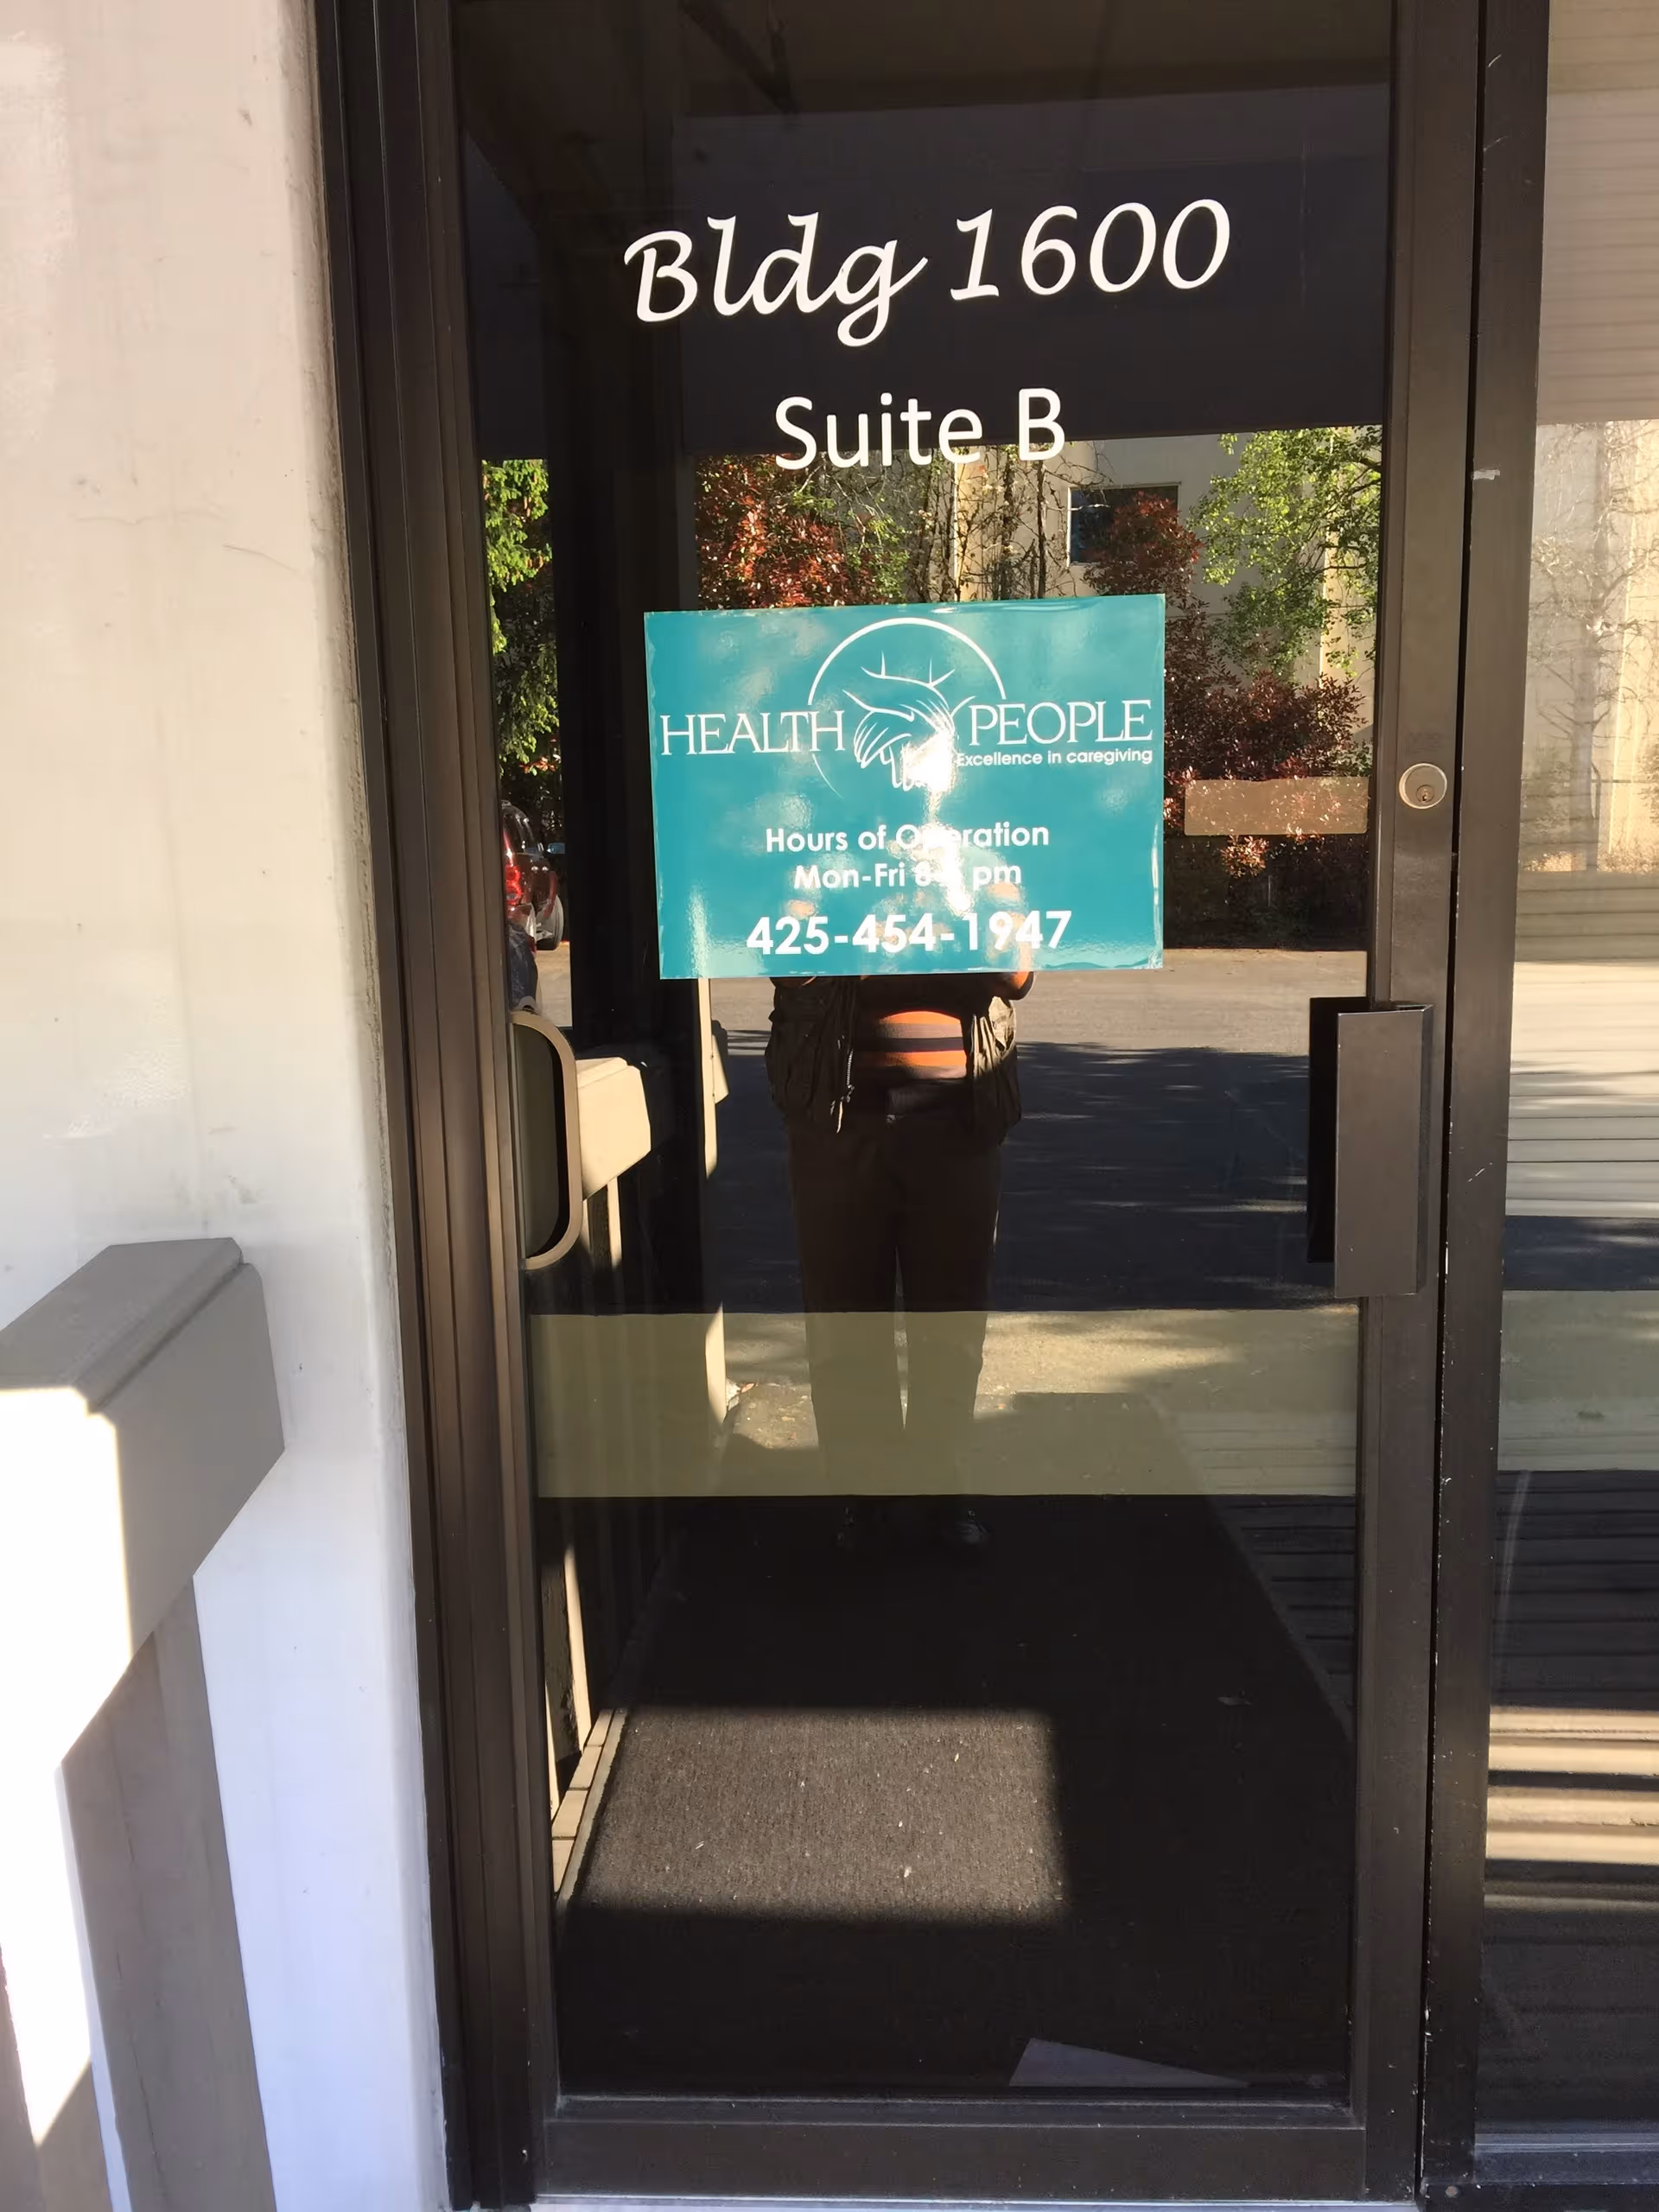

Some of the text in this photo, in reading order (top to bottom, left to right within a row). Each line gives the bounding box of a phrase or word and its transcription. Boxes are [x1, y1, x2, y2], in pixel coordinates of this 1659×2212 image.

[624, 198, 1231, 347] Bldg 1600
[774, 387, 1067, 471] Suite B
[661, 700, 1154, 756] HEALTH PEOPLE
[957, 747, 1154, 767] Excellence in caregiving
[766, 821, 1050, 853] Hours of Oeration
[793, 861, 906, 889] Mon-Fri
[972, 865, 1022, 891] pm
[746, 910, 1072, 955] 425-454-1947
